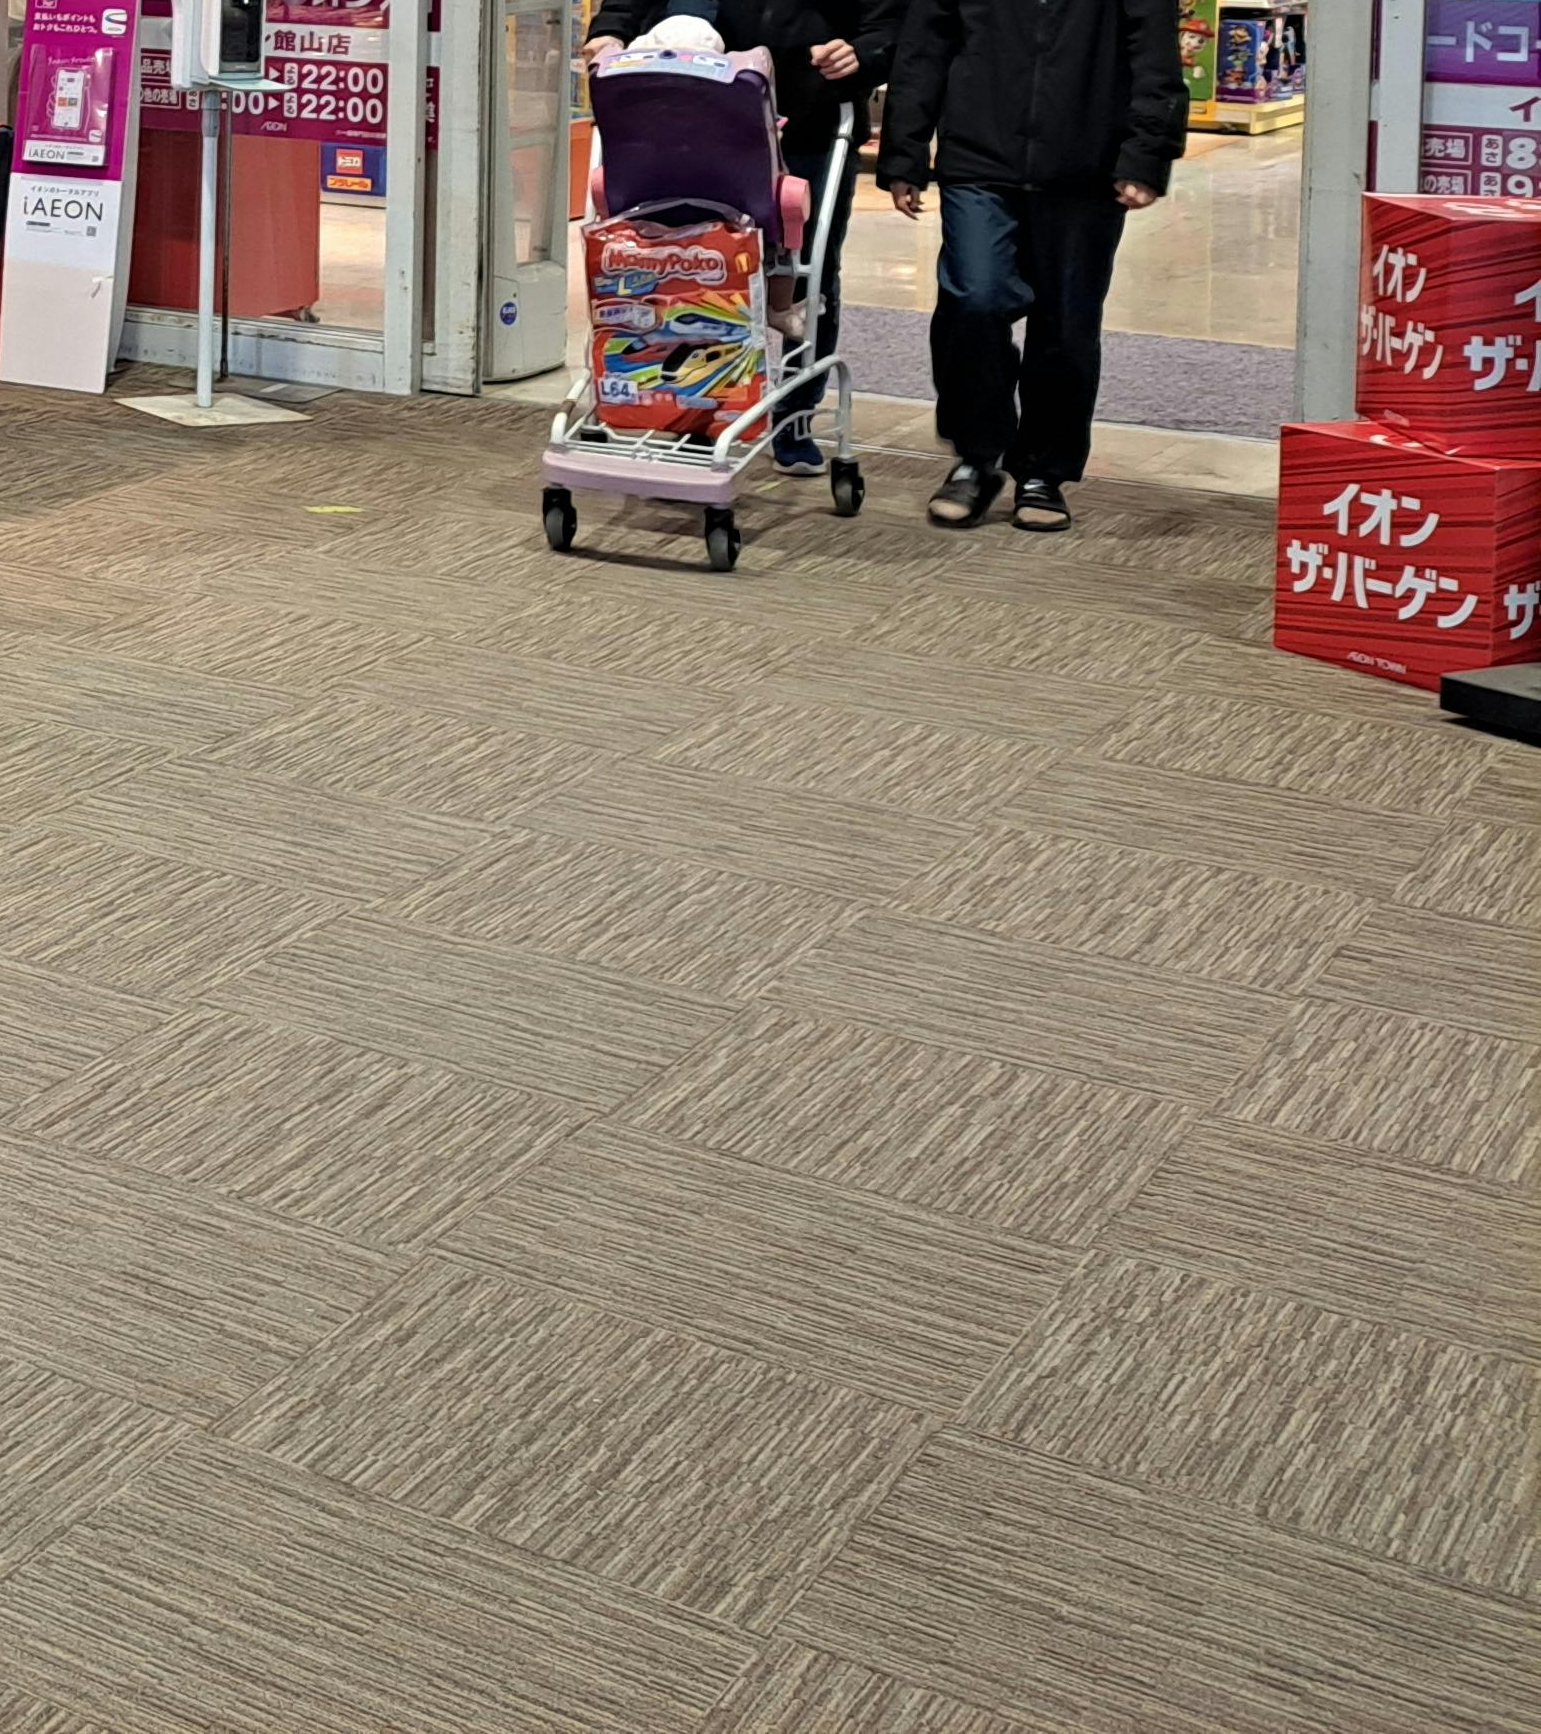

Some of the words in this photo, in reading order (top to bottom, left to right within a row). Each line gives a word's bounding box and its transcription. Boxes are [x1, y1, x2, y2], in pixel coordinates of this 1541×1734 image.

[265, 29, 352, 56] 館山店
[301, 63, 384, 94] 22:00
[300, 93, 383, 125] 22:00
[1421, 137, 1466, 159] 売場
[23, 196, 104, 222] iAEON
[1372, 244, 1427, 303] イオン
[1360, 304, 1444, 380] ザ・バーゲン
[1323, 484, 1440, 547] イオン
[1286, 540, 1479, 629] ザ・バーゲン
